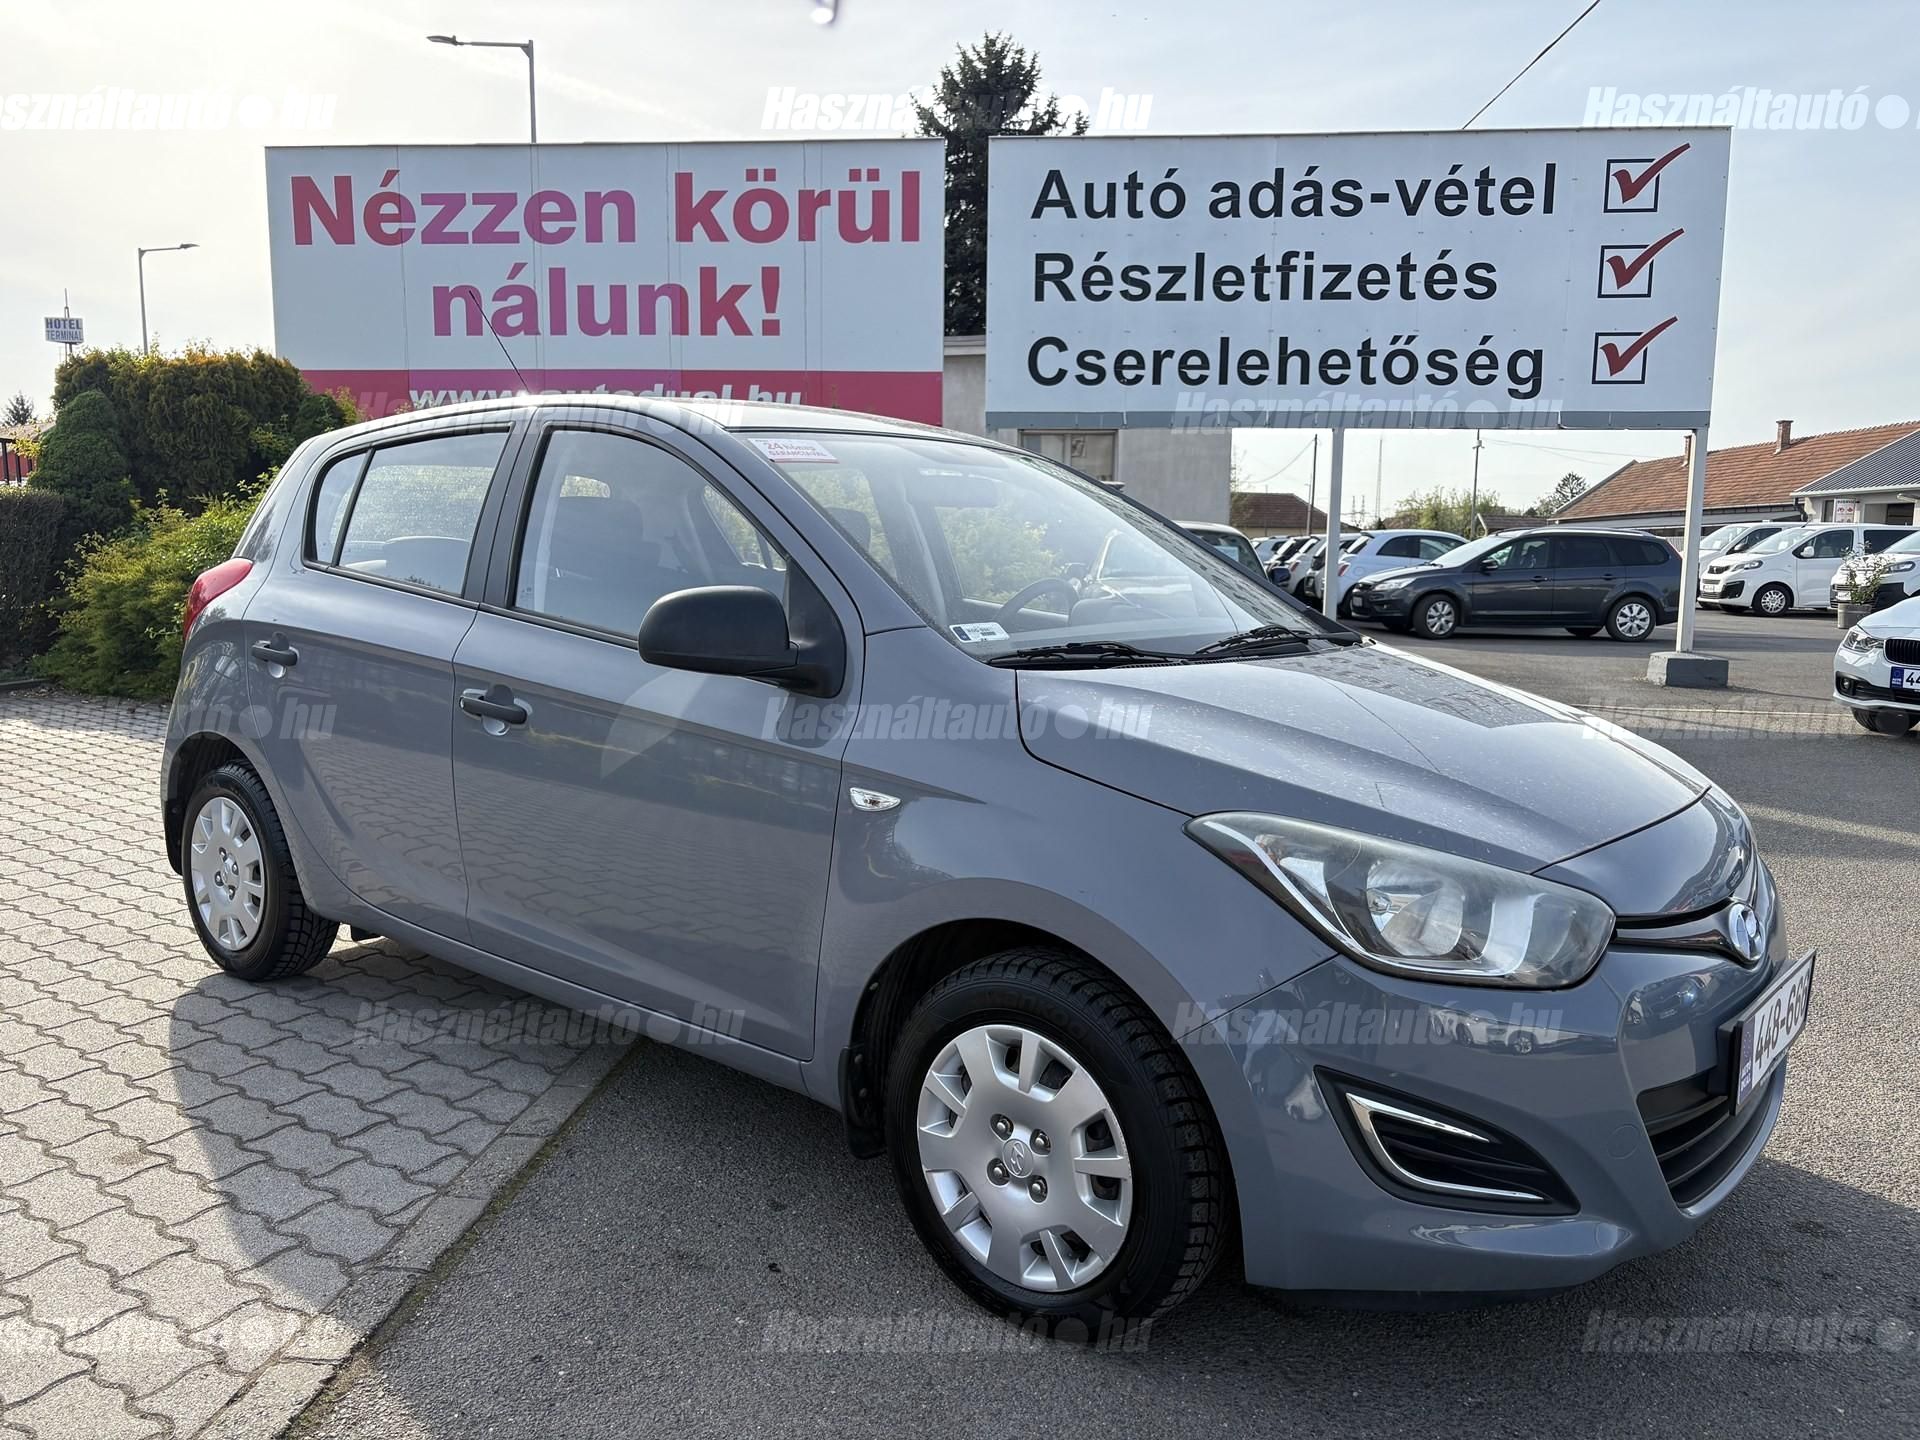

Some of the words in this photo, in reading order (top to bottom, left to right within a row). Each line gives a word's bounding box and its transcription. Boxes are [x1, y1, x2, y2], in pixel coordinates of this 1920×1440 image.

[290, 169, 637, 247] Nézzen
[674, 168, 921, 244] körül
[1030, 166, 1187, 219] Autó
[1209, 162, 1557, 218] adás-vétel
[432, 262, 782, 338] nálunk!
[1034, 248, 1499, 303] Részletfizetés
[45, 318, 82, 329] HOTEL
[46, 330, 83, 341] TERMINAL
[1027, 333, 1546, 400] Cserelehetőség
